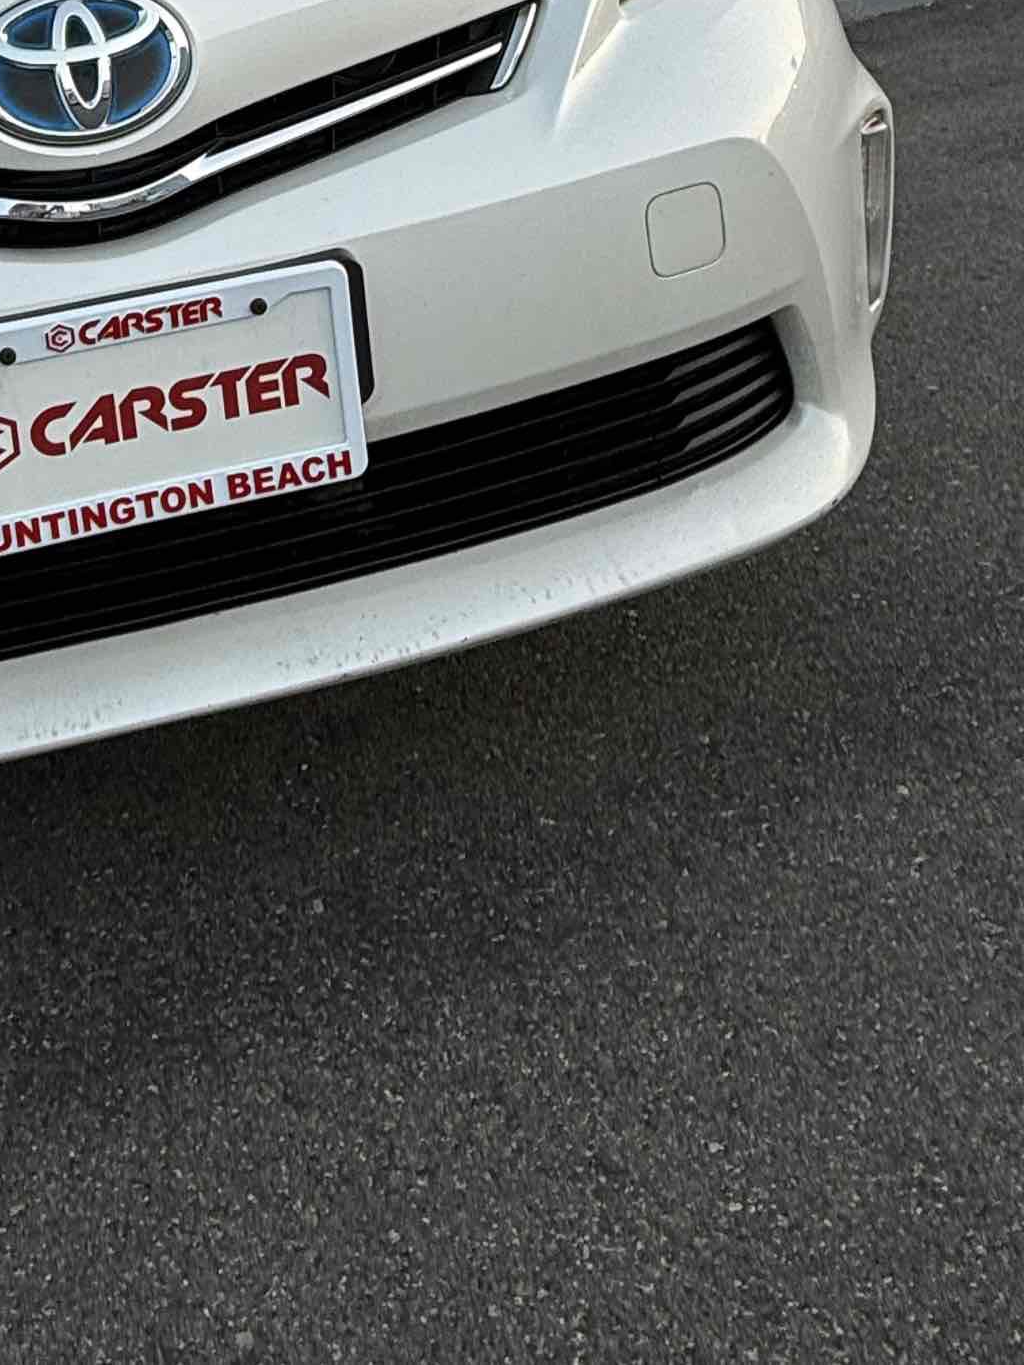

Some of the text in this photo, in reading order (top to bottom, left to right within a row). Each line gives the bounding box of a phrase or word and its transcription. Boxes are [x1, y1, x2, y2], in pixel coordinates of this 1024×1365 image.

[78, 296, 223, 346] CARSTER
[30, 352, 330, 457] CARSTER
[227, 450, 353, 501] BEACH
